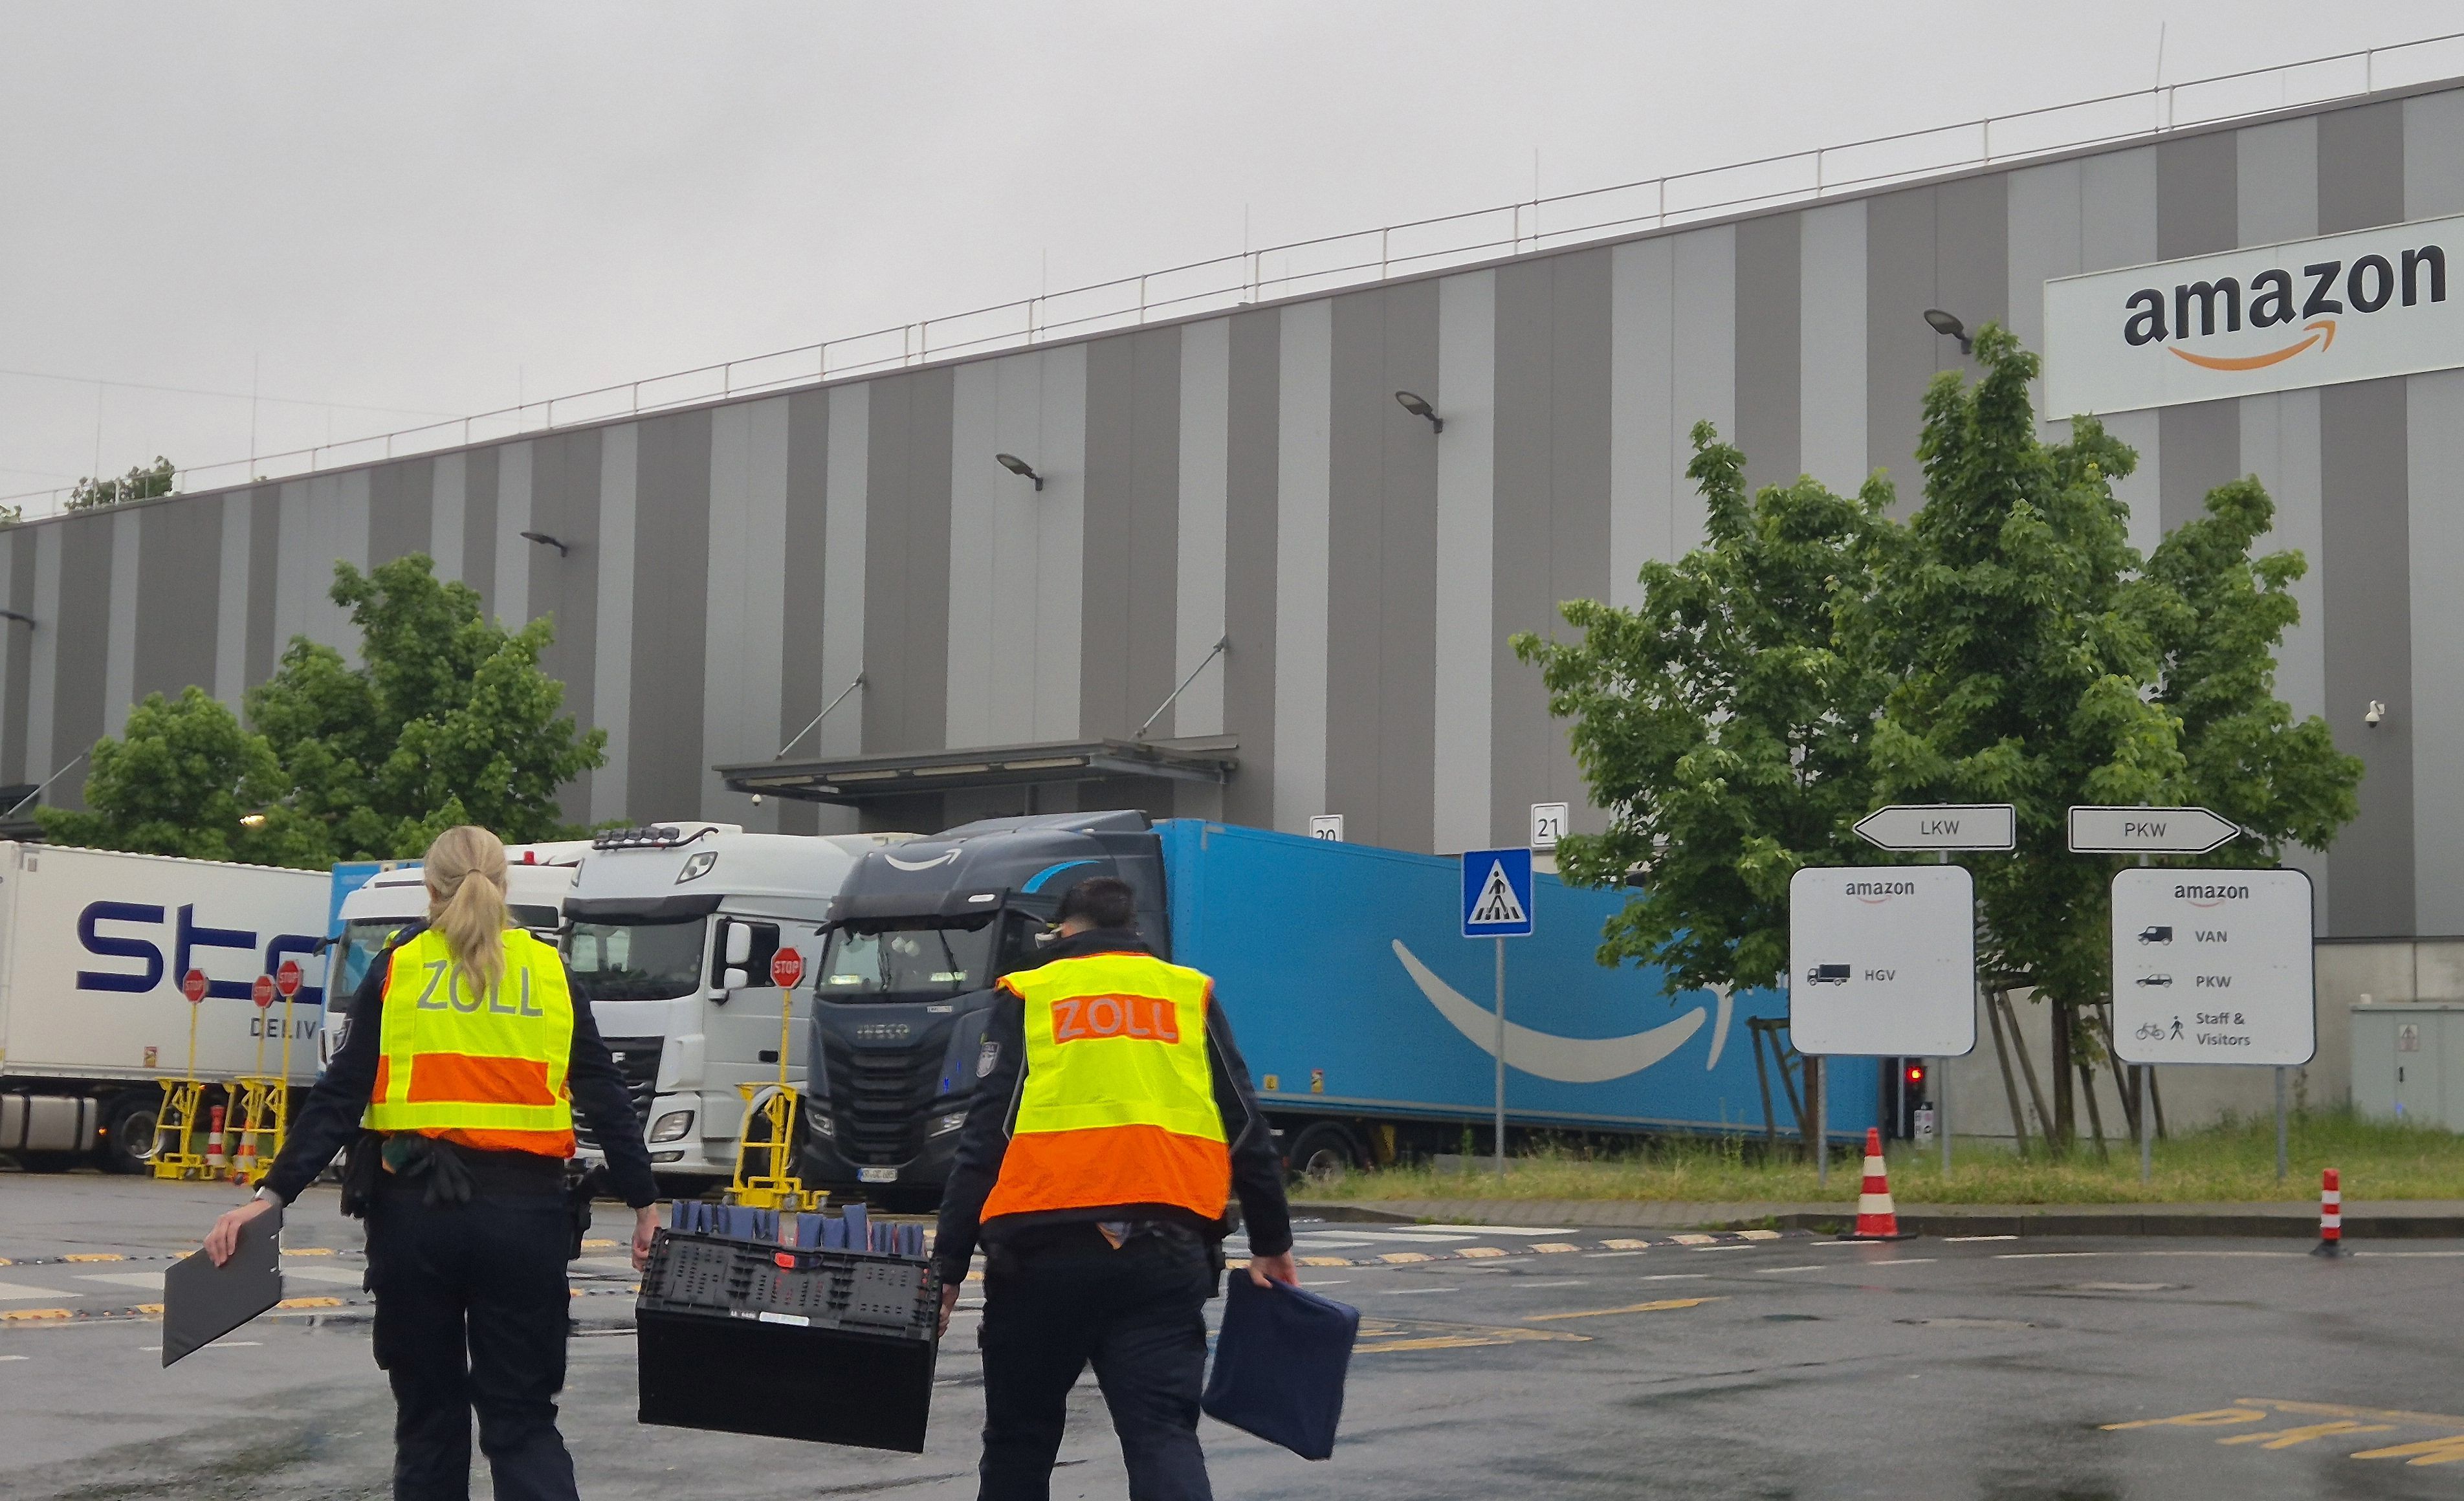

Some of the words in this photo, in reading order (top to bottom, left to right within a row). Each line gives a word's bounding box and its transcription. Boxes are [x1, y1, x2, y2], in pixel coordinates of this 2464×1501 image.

[2124, 244, 2446, 346] amazon
[1538, 818, 1557, 837] 21
[1921, 820, 1959, 835] LKW
[2125, 822, 2166, 837] PKW
[1845, 882, 1915, 895] amazon
[2174, 885, 2249, 899] amazon
[2195, 931, 2227, 943] VAN
[775, 961, 799, 974] STOP
[1865, 970, 1895, 981] HGV
[2196, 976, 2232, 987] PKW
[417, 959, 543, 1016] ZOLL
[1053, 998, 1176, 1038] ZOLL
[2196, 1013, 2230, 1025] Staff
[2234, 1013, 2244, 1025] &
[2197, 1033, 2251, 1046] Visitors
